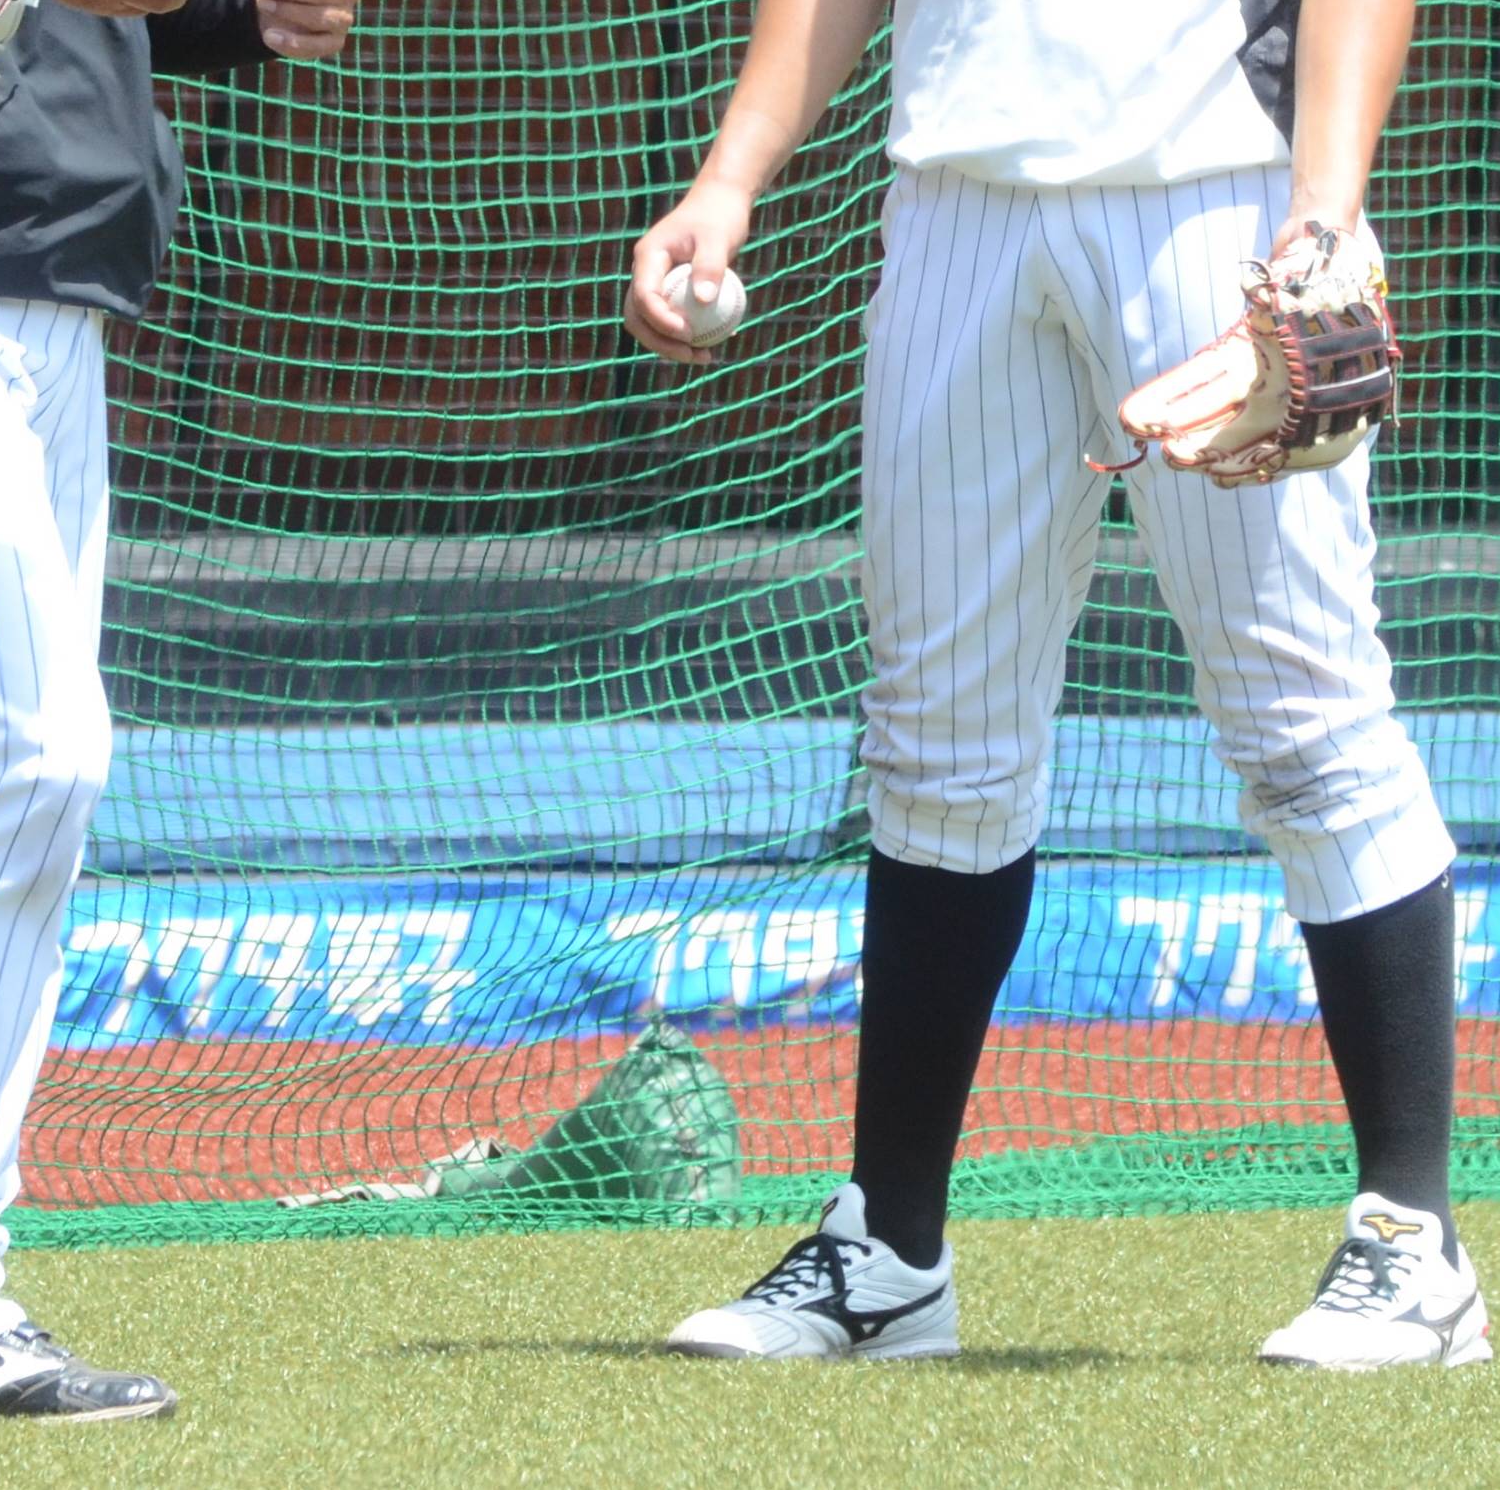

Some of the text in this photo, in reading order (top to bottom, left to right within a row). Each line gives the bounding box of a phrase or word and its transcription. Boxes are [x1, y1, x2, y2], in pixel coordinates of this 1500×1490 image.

[69, 911, 477, 1033] フクダ電子
[607, 910, 866, 1020] フクダ
